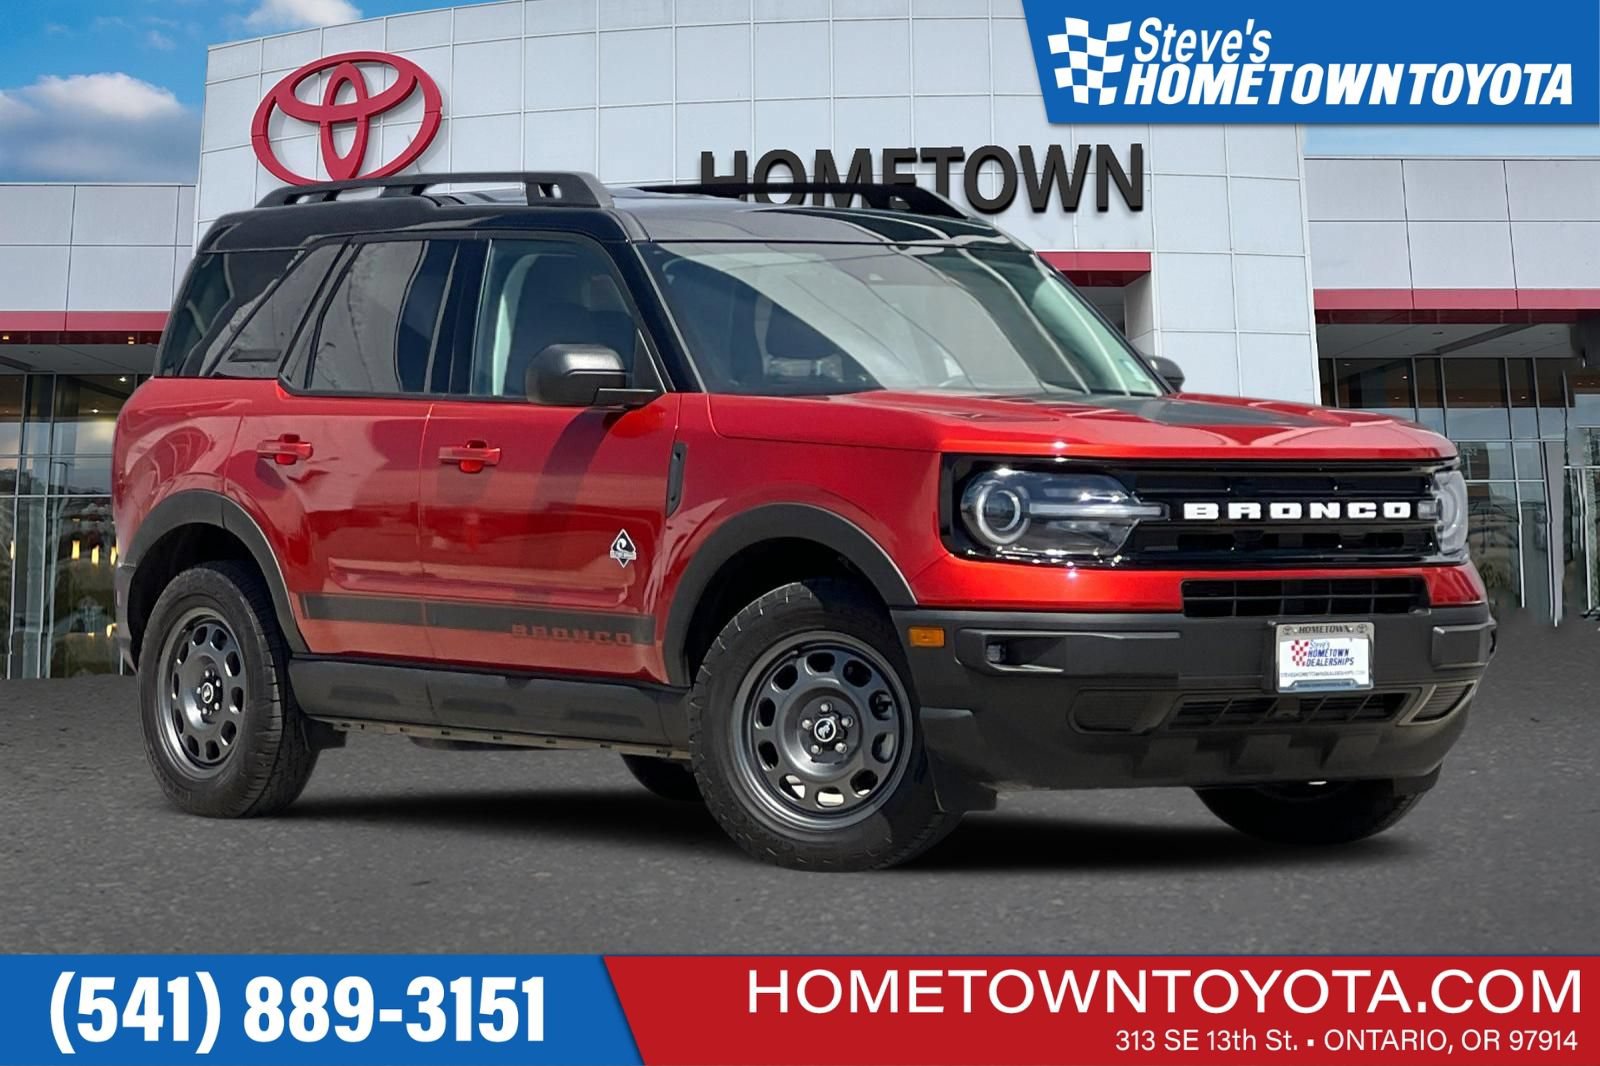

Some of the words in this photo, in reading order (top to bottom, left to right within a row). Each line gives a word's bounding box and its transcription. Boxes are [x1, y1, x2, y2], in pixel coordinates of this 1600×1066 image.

[699, 143, 1144, 213] HOMETOWN
[1183, 502, 1412, 520] BRONCO
[511, 624, 633, 646] BRONCO
[1299, 624, 1351, 634] HOMETOWN
[1307, 648, 1350, 658] HOMETOWN
[1306, 657, 1355, 667] DEALERSHIPS
